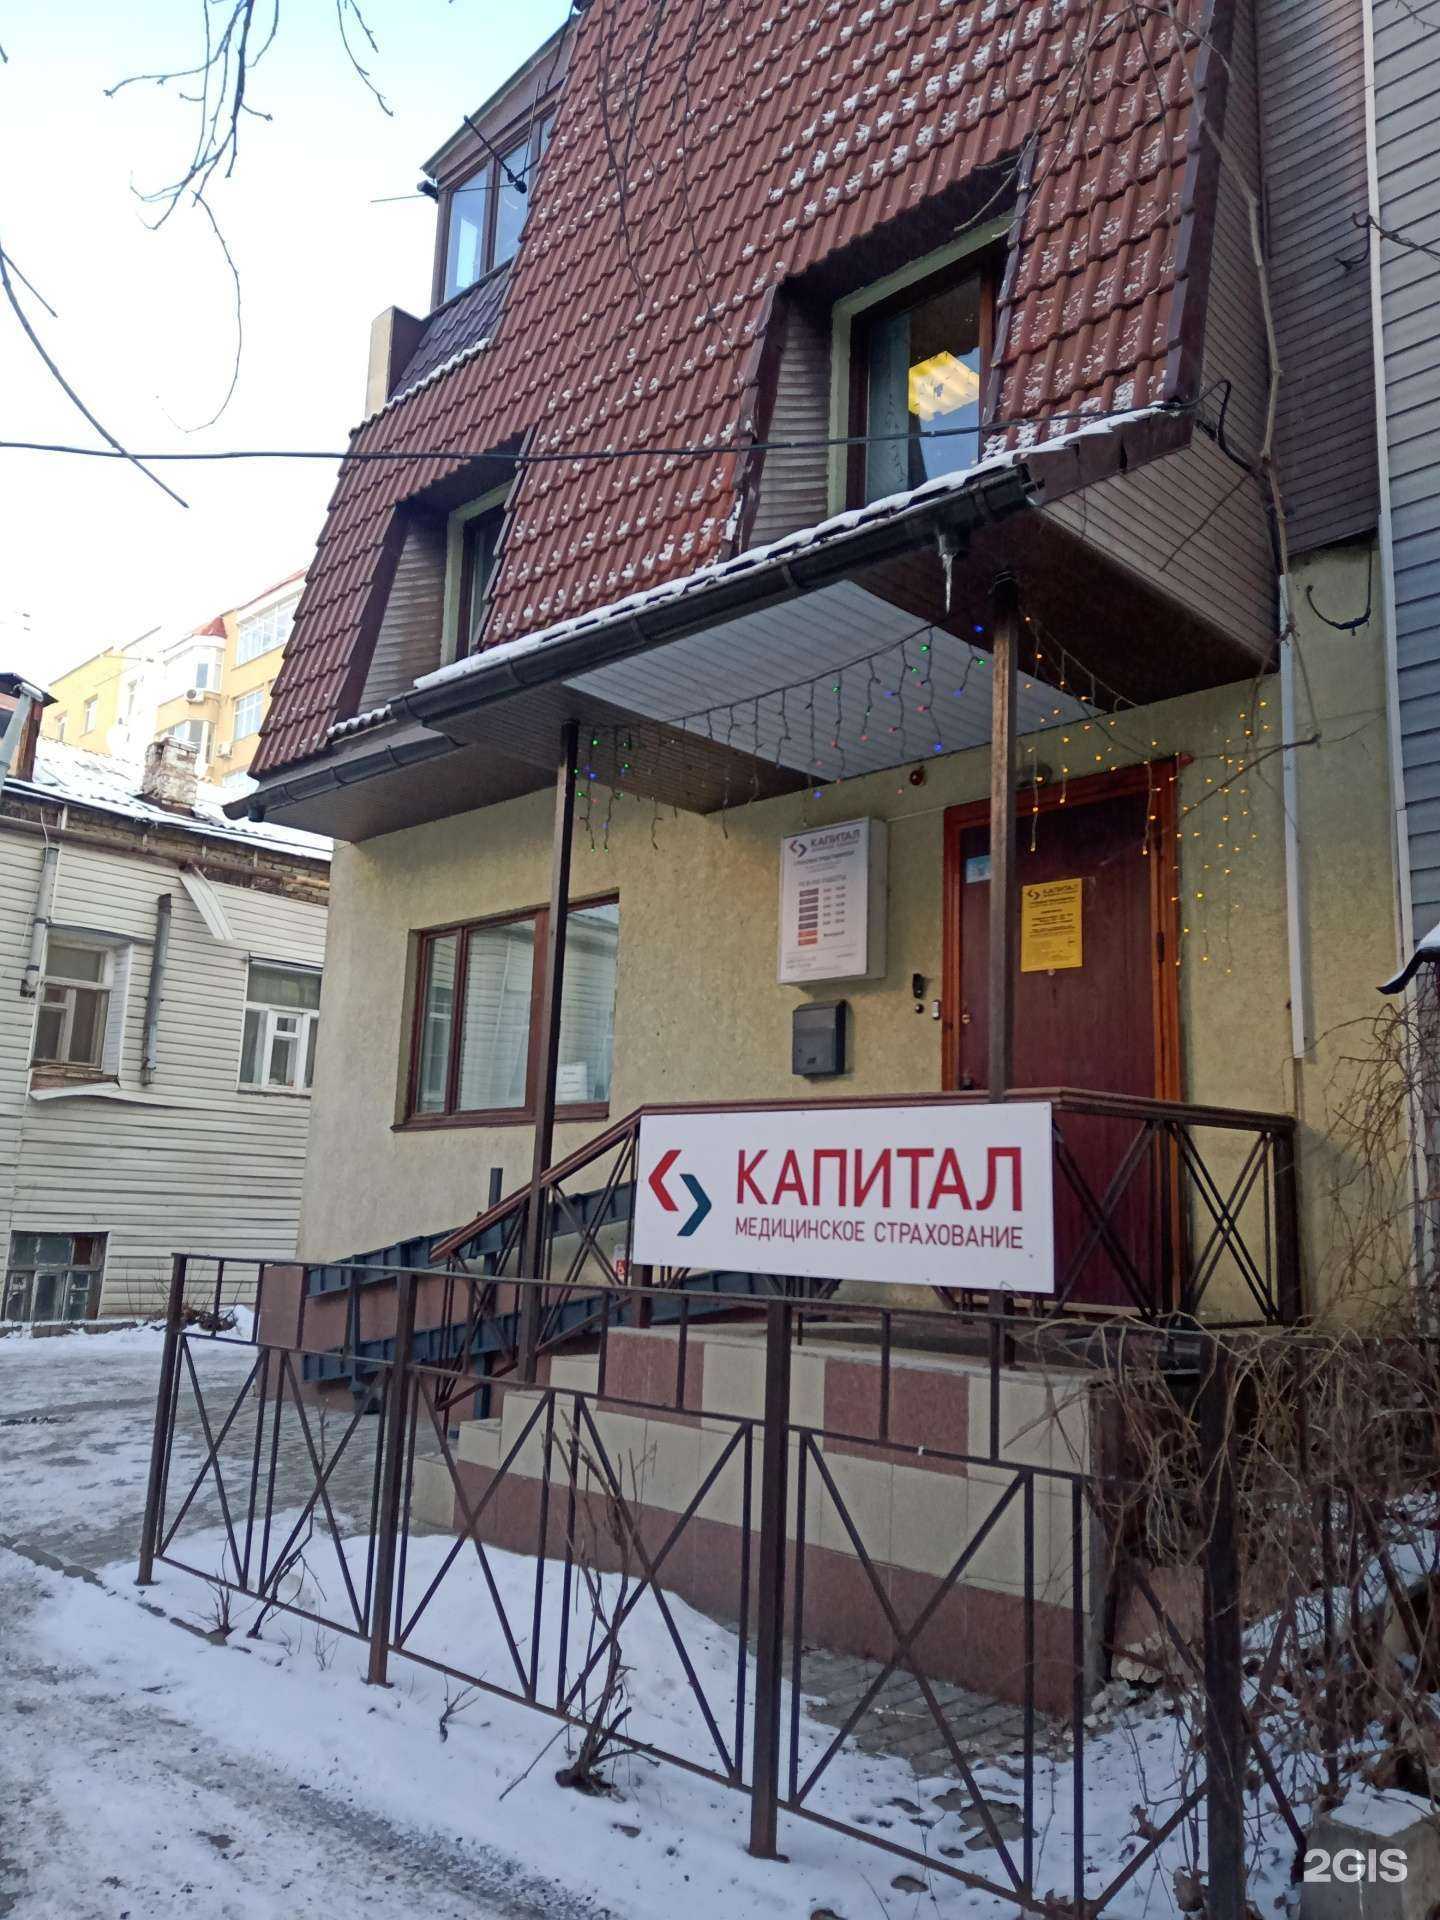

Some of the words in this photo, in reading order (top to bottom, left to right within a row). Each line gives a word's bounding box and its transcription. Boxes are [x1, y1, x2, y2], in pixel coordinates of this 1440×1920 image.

[811, 829, 860, 846] КАПИТАЛ
[736, 1147, 1022, 1211] КАПИТАЛ
[735, 1216, 865, 1242] МЕДИЦИНСКОЕ
[873, 1221, 1023, 1250] СТРАХОВАНИЕ
